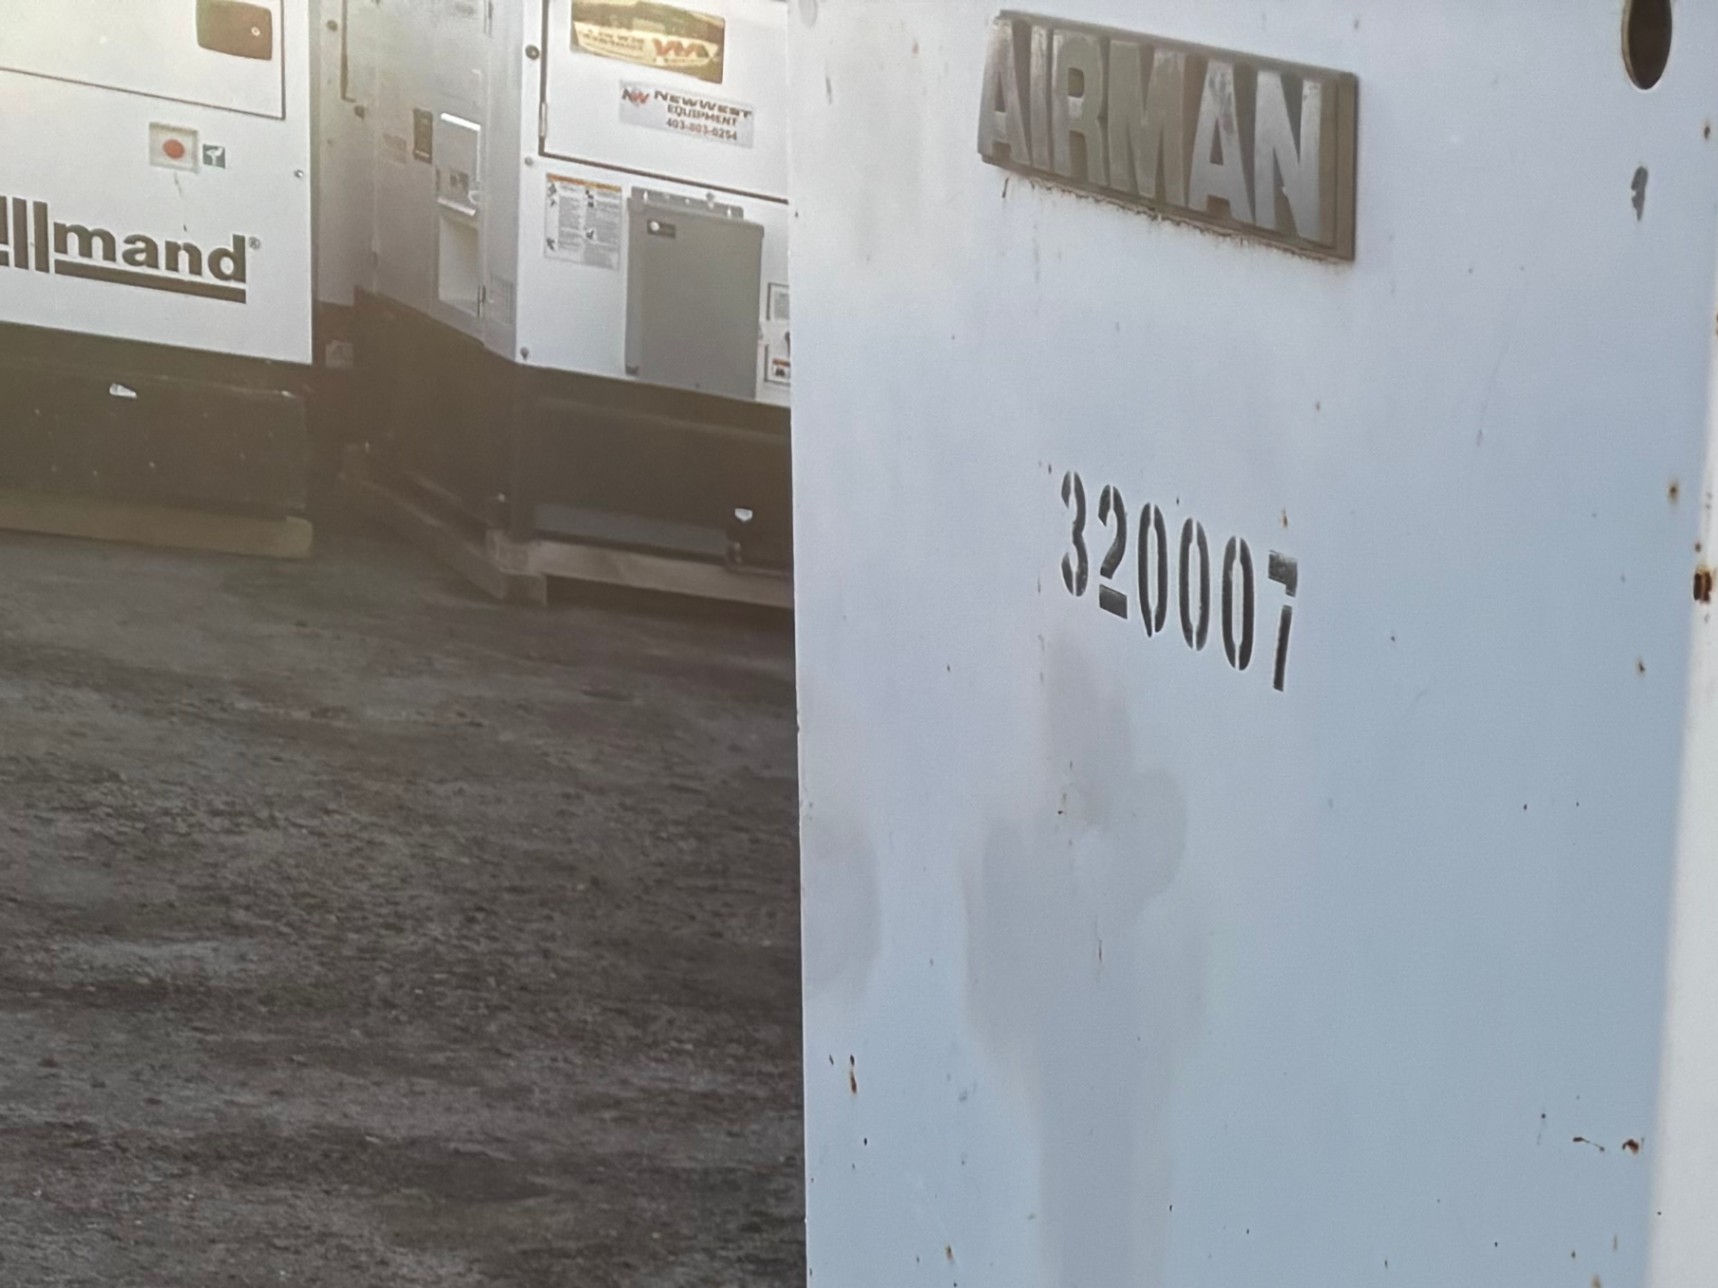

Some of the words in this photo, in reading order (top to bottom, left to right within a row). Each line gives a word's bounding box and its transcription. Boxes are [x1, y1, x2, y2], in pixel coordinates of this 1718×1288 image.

[667, 104, 737, 127] EQUIPMENT
[978, 17, 1324, 242] AIRMAN
[1060, 470, 1298, 692] 320007
